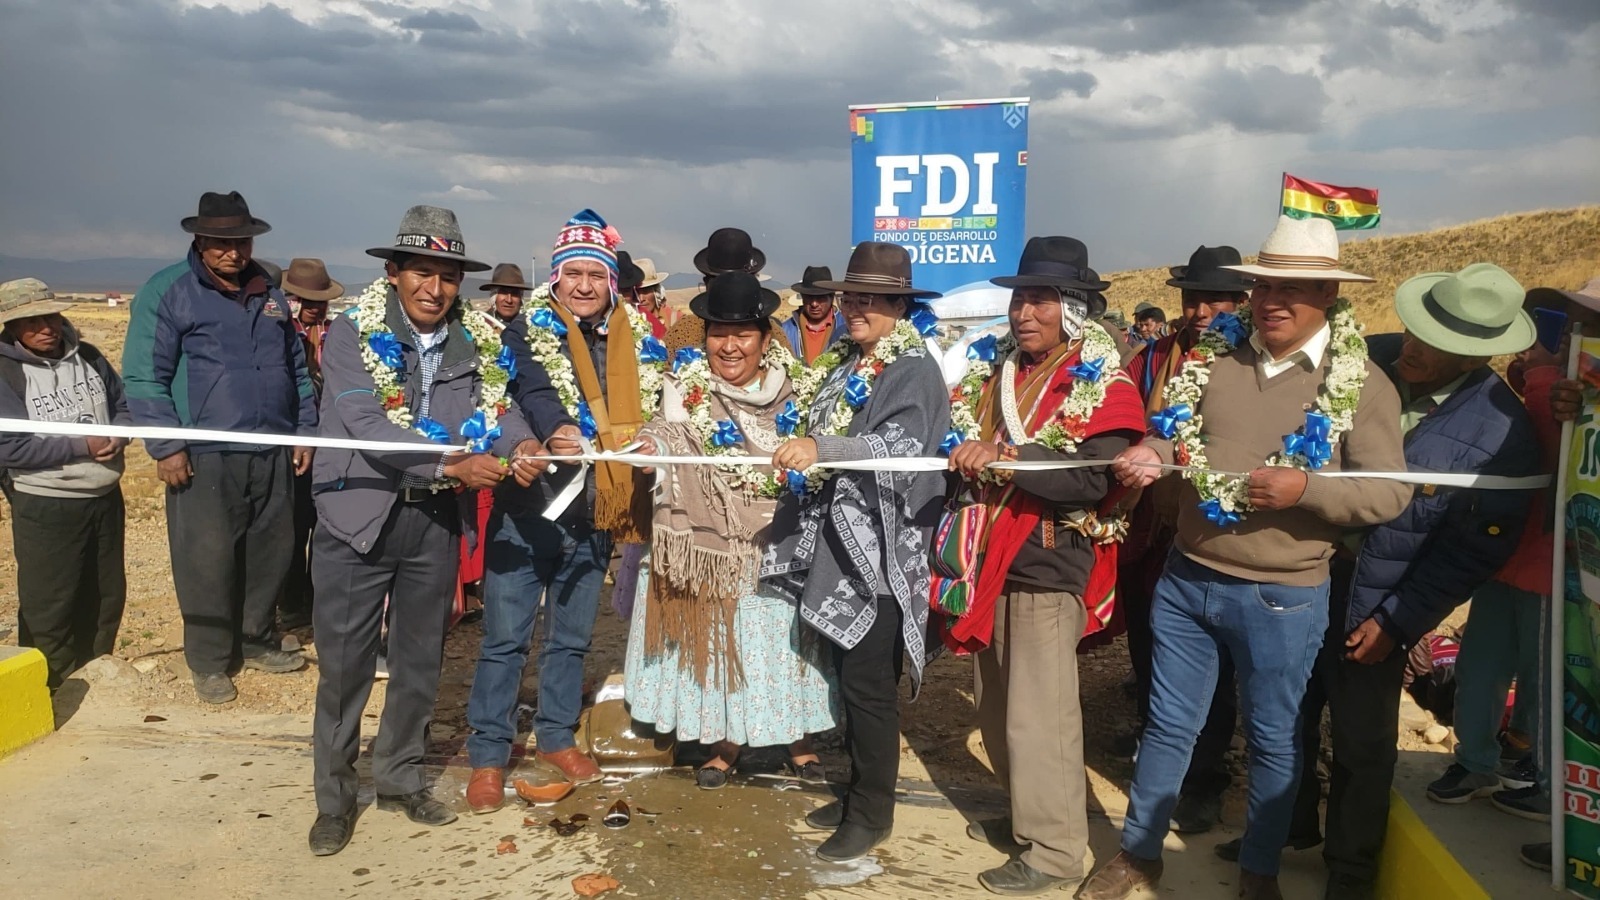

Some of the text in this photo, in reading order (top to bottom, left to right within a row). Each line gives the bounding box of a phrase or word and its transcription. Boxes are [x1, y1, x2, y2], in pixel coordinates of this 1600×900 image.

[875, 152, 999, 217] FDI
[874, 231, 997, 242] FONDO DE DESARROLLO
[904, 241, 996, 264] DÍGENA
[32, 388, 73, 416] PENN
[73, 375, 106, 402] STAT
